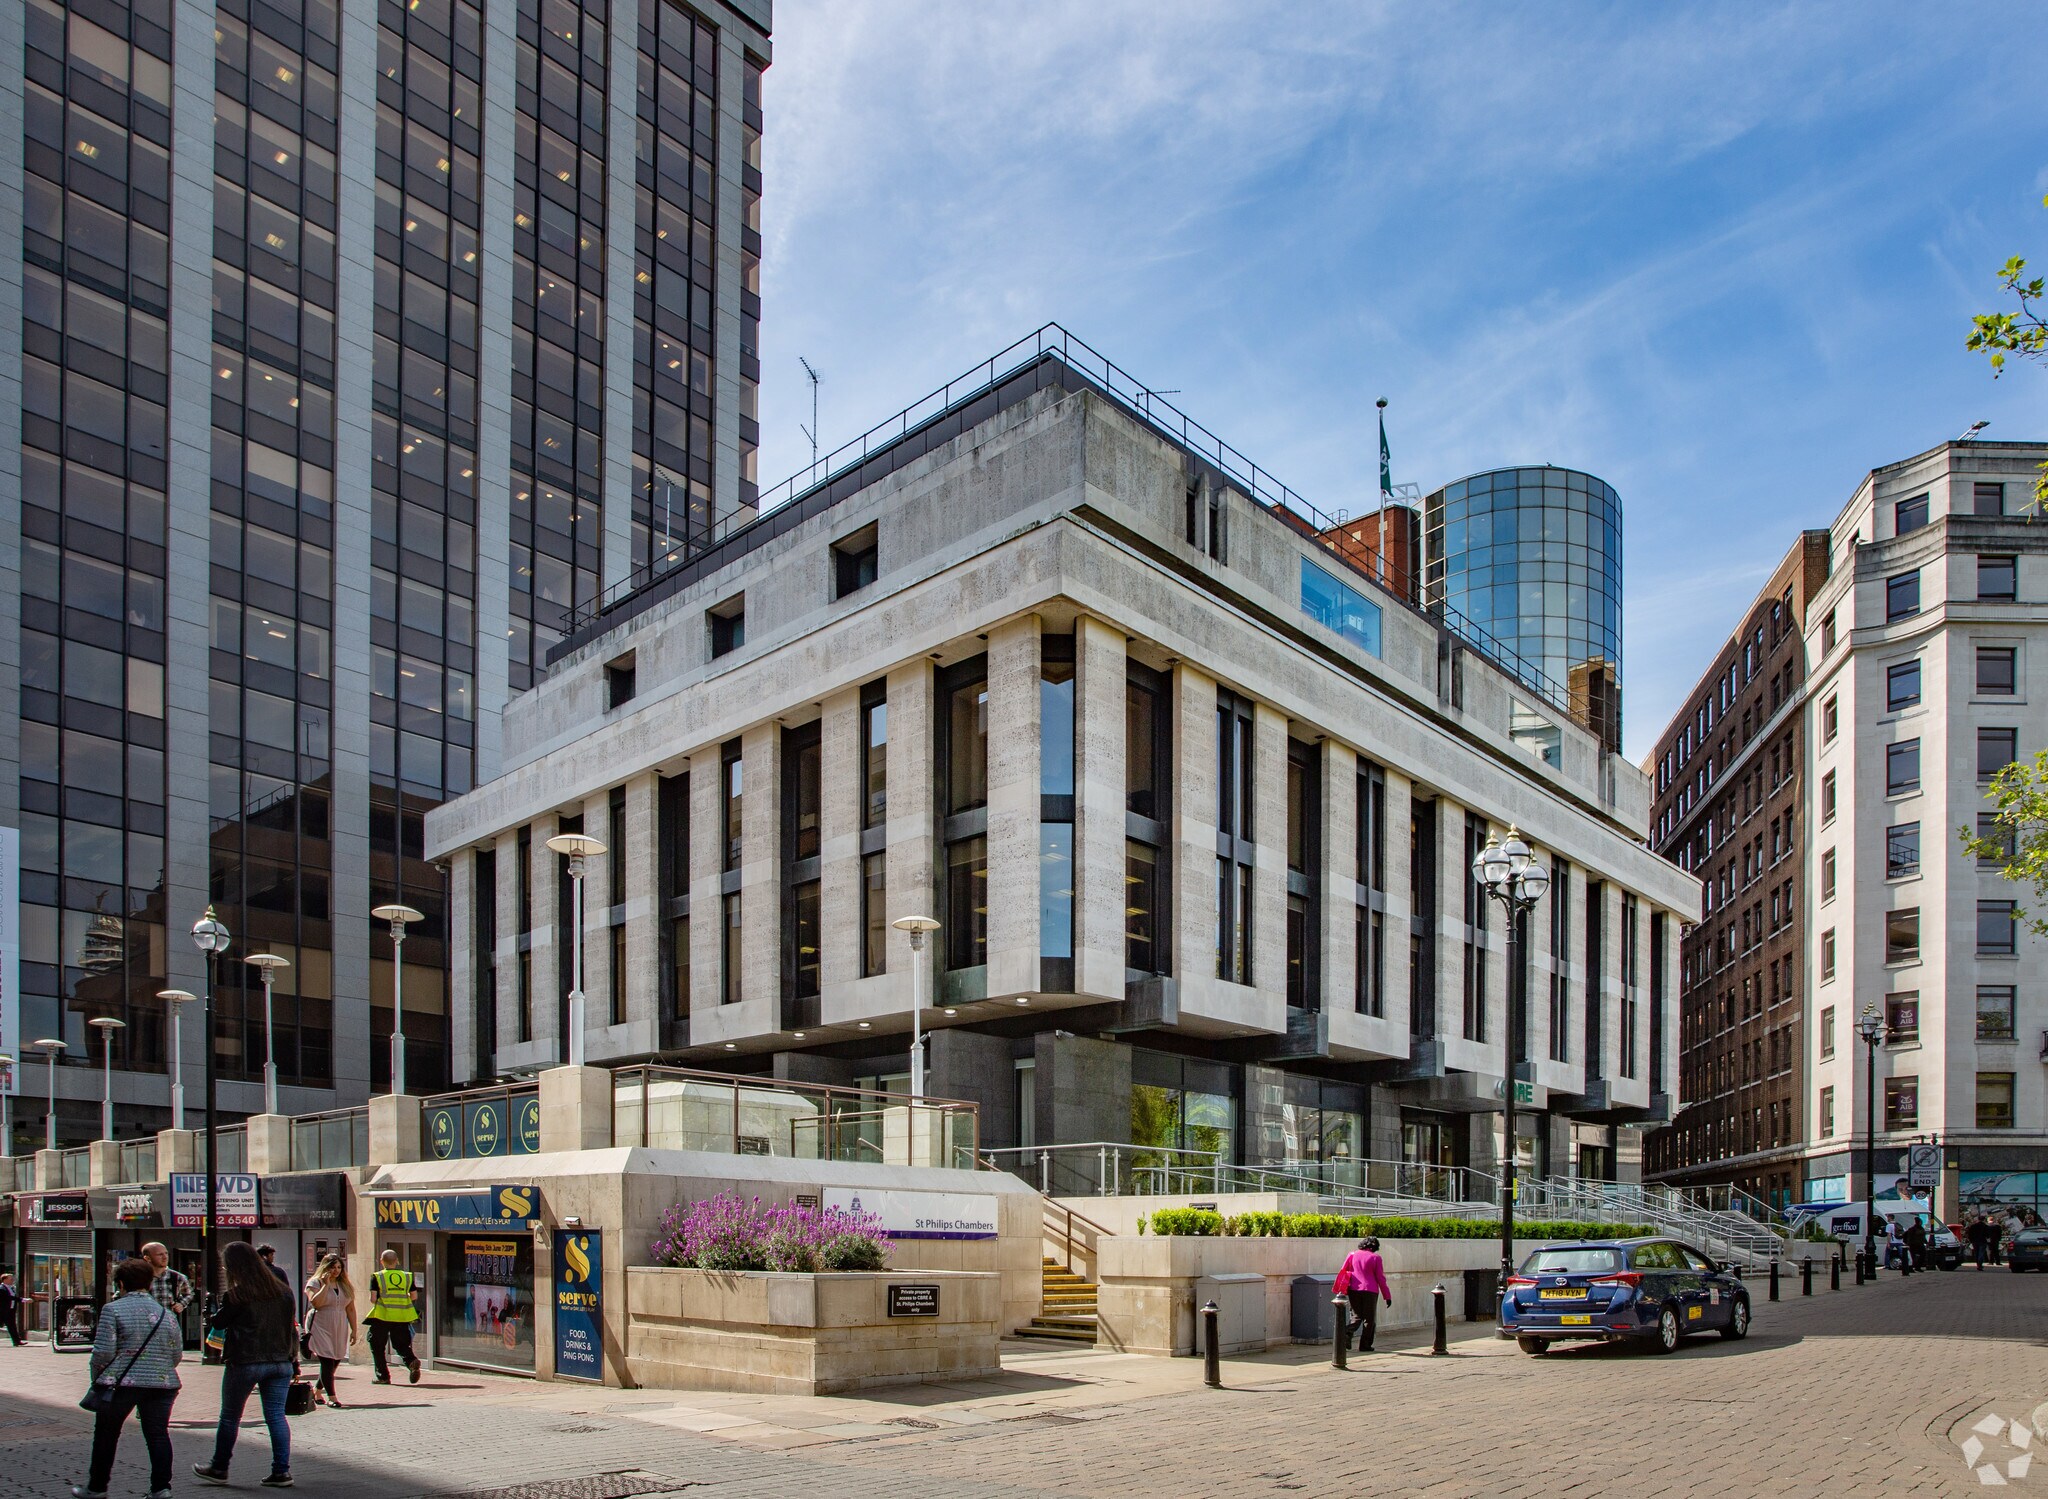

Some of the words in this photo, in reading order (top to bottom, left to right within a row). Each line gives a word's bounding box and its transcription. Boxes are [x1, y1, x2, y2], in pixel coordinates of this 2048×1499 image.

[435, 1138, 451, 1146] serve
[477, 1134, 494, 1142] serve
[378, 1199, 440, 1224] serve
[177, 1216, 200, 1225] 0121
[228, 1216, 255, 1225] 6540
[915, 1219, 924, 1228] St
[925, 1220, 953, 1230] Philips
[955, 1220, 994, 1230] Chambers
[559, 1291, 597, 1307] serve
[569, 1329, 587, 1340] FOOD,
[565, 1340, 586, 1350] DRINKS
[587, 1342, 591, 1351] &
[563, 1351, 577, 1361] PING
[577, 1353, 594, 1363] PONG
